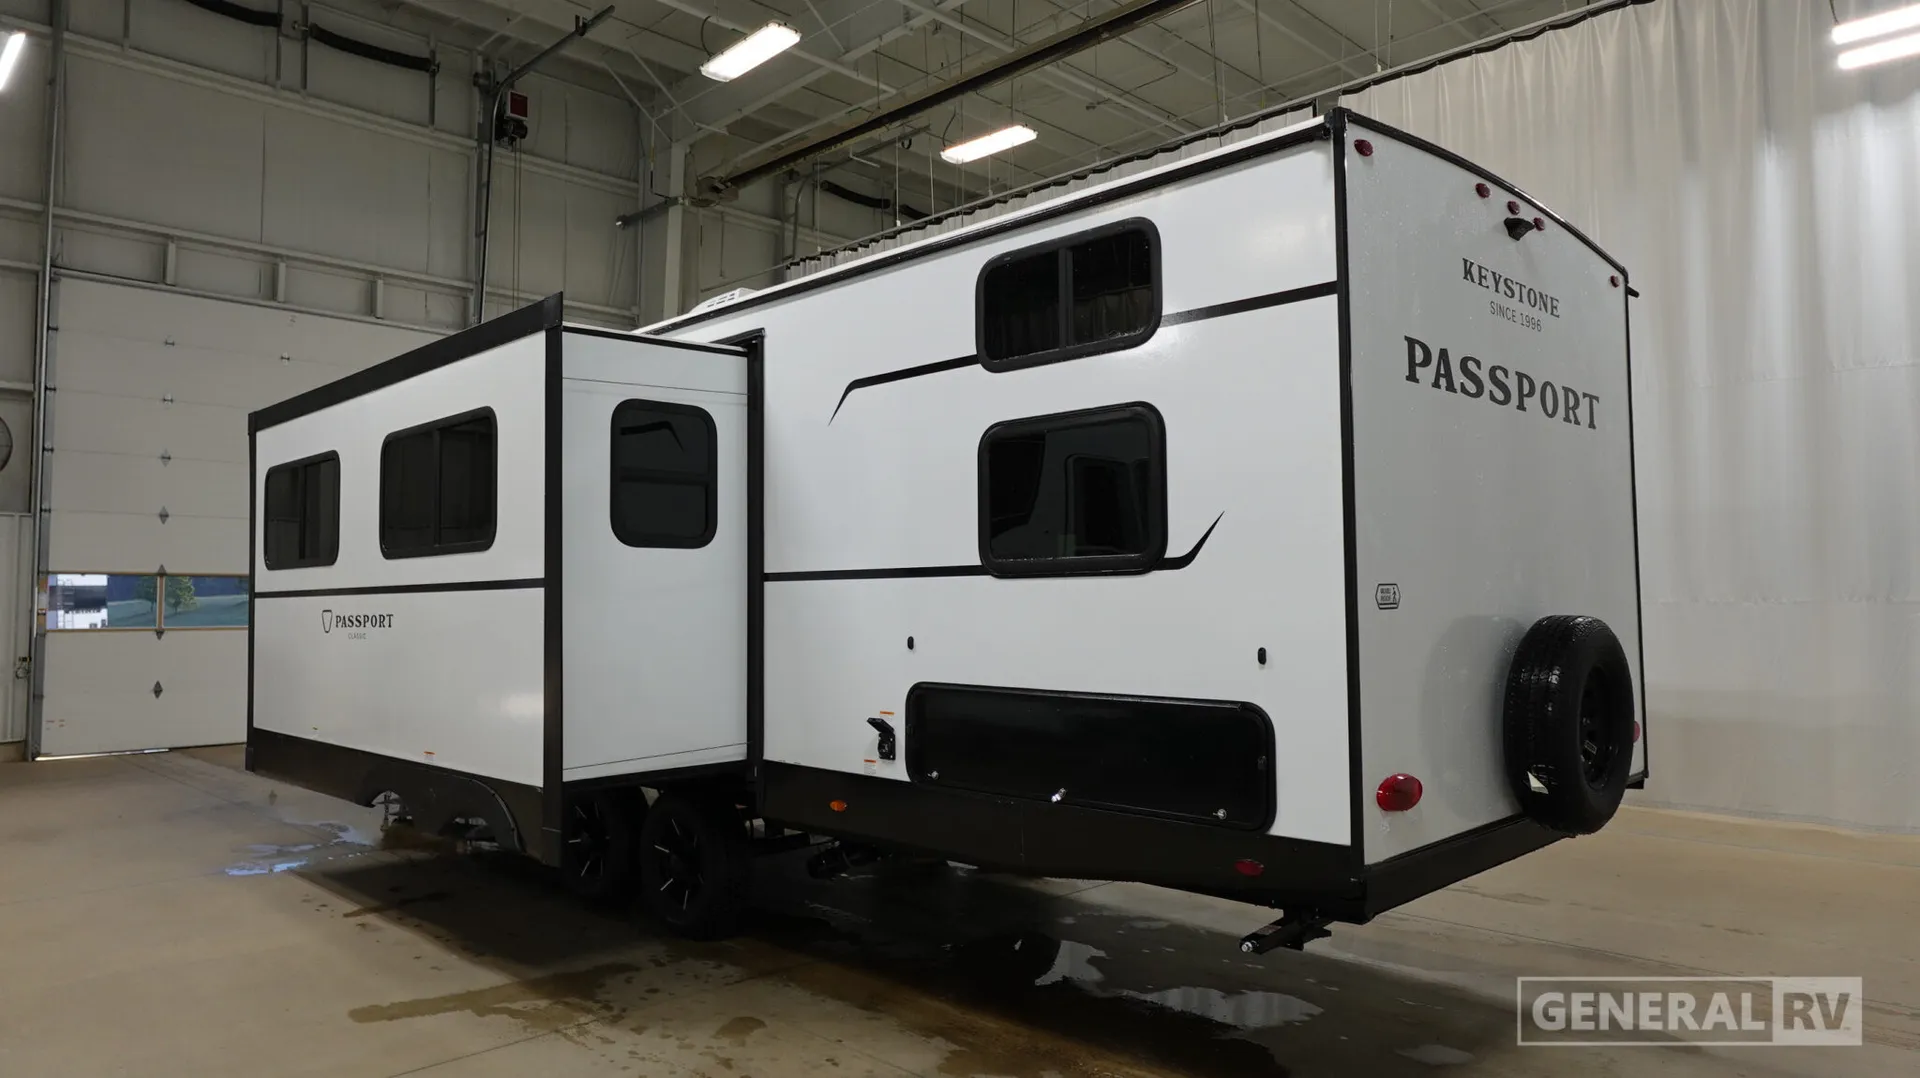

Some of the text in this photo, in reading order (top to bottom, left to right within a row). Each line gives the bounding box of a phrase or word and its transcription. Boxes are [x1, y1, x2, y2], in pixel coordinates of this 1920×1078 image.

[1462, 258, 1560, 318] KEYSTONE
[1490, 300, 1542, 332] SINCE 1996
[1404, 335, 1600, 430] PASSPORT
[335, 614, 394, 628] PASSPORT
